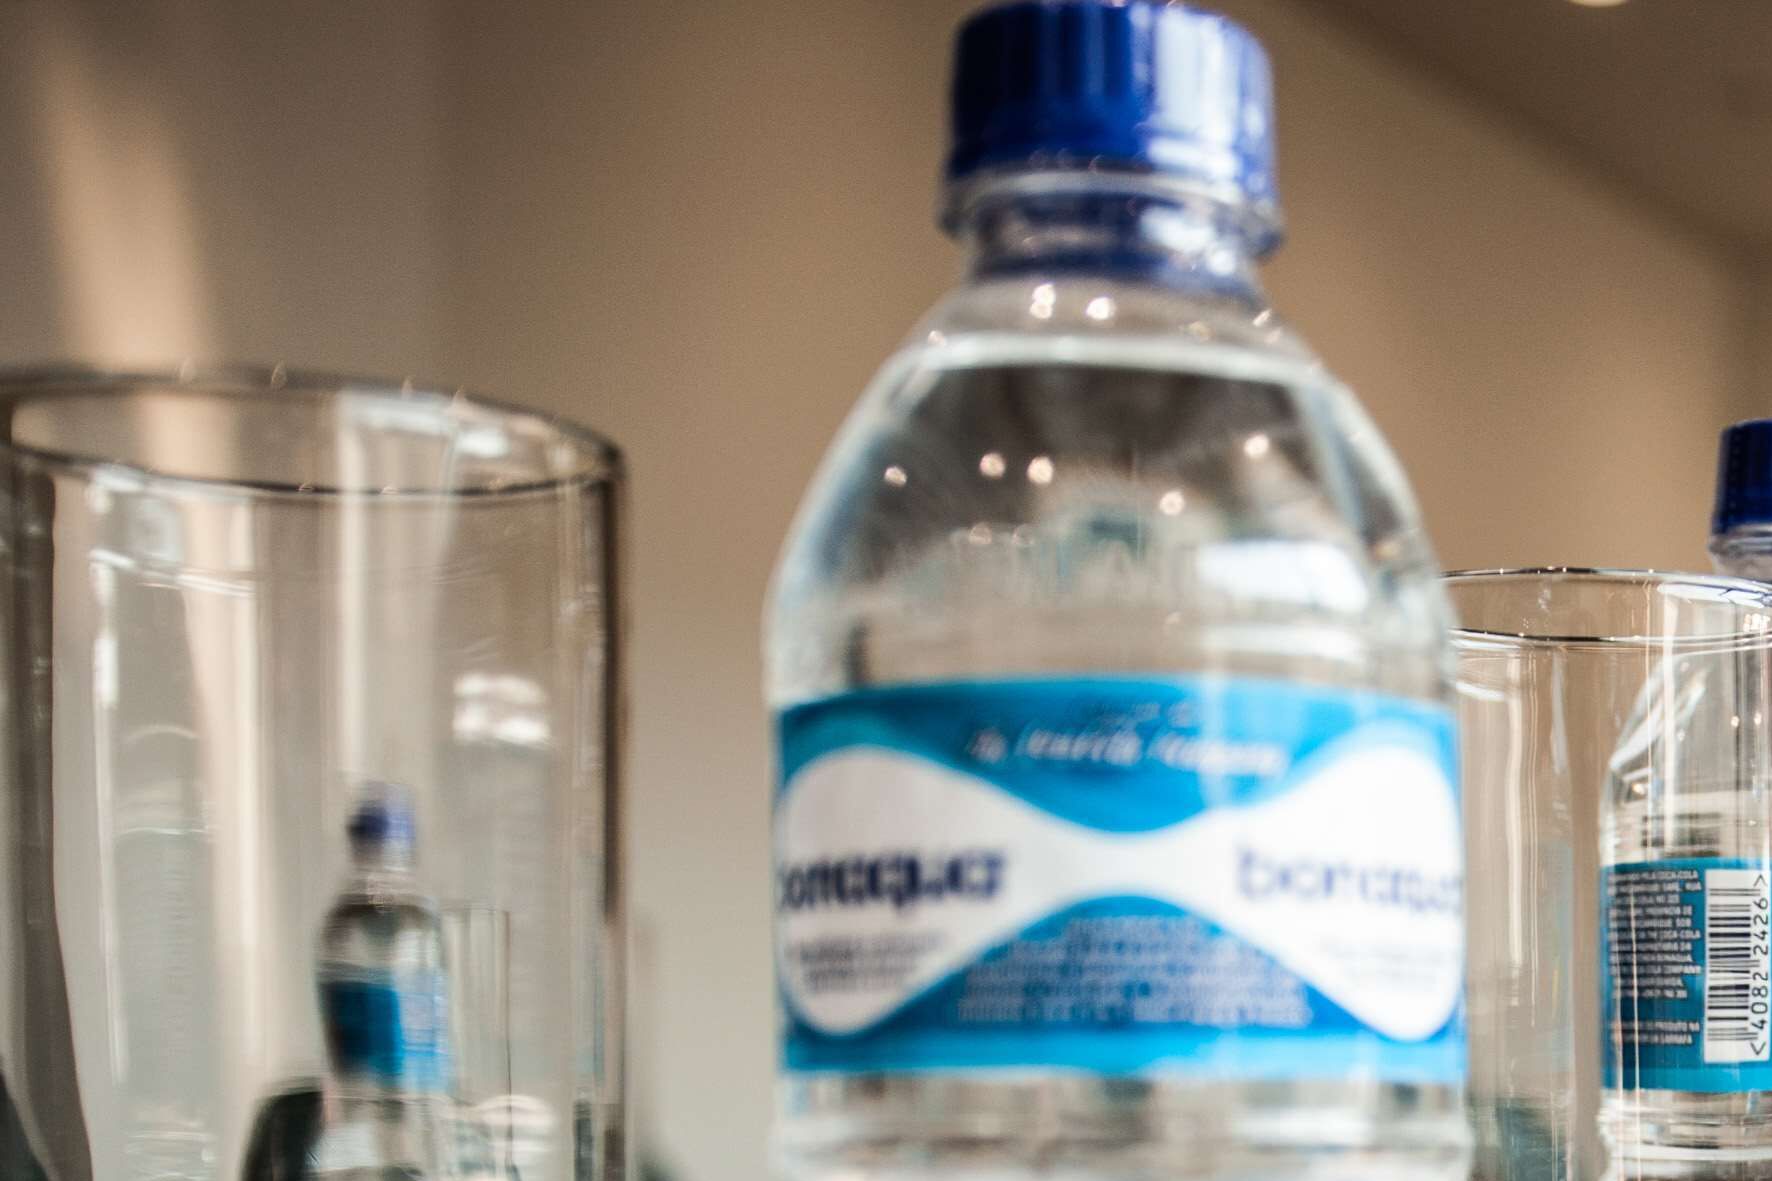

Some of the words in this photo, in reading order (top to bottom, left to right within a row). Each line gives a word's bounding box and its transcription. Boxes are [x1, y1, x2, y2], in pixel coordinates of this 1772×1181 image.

[782, 850, 1006, 918] onaqua
[1753, 897, 1769, 956] 2426
[1751, 972, 1769, 1030] 4082
